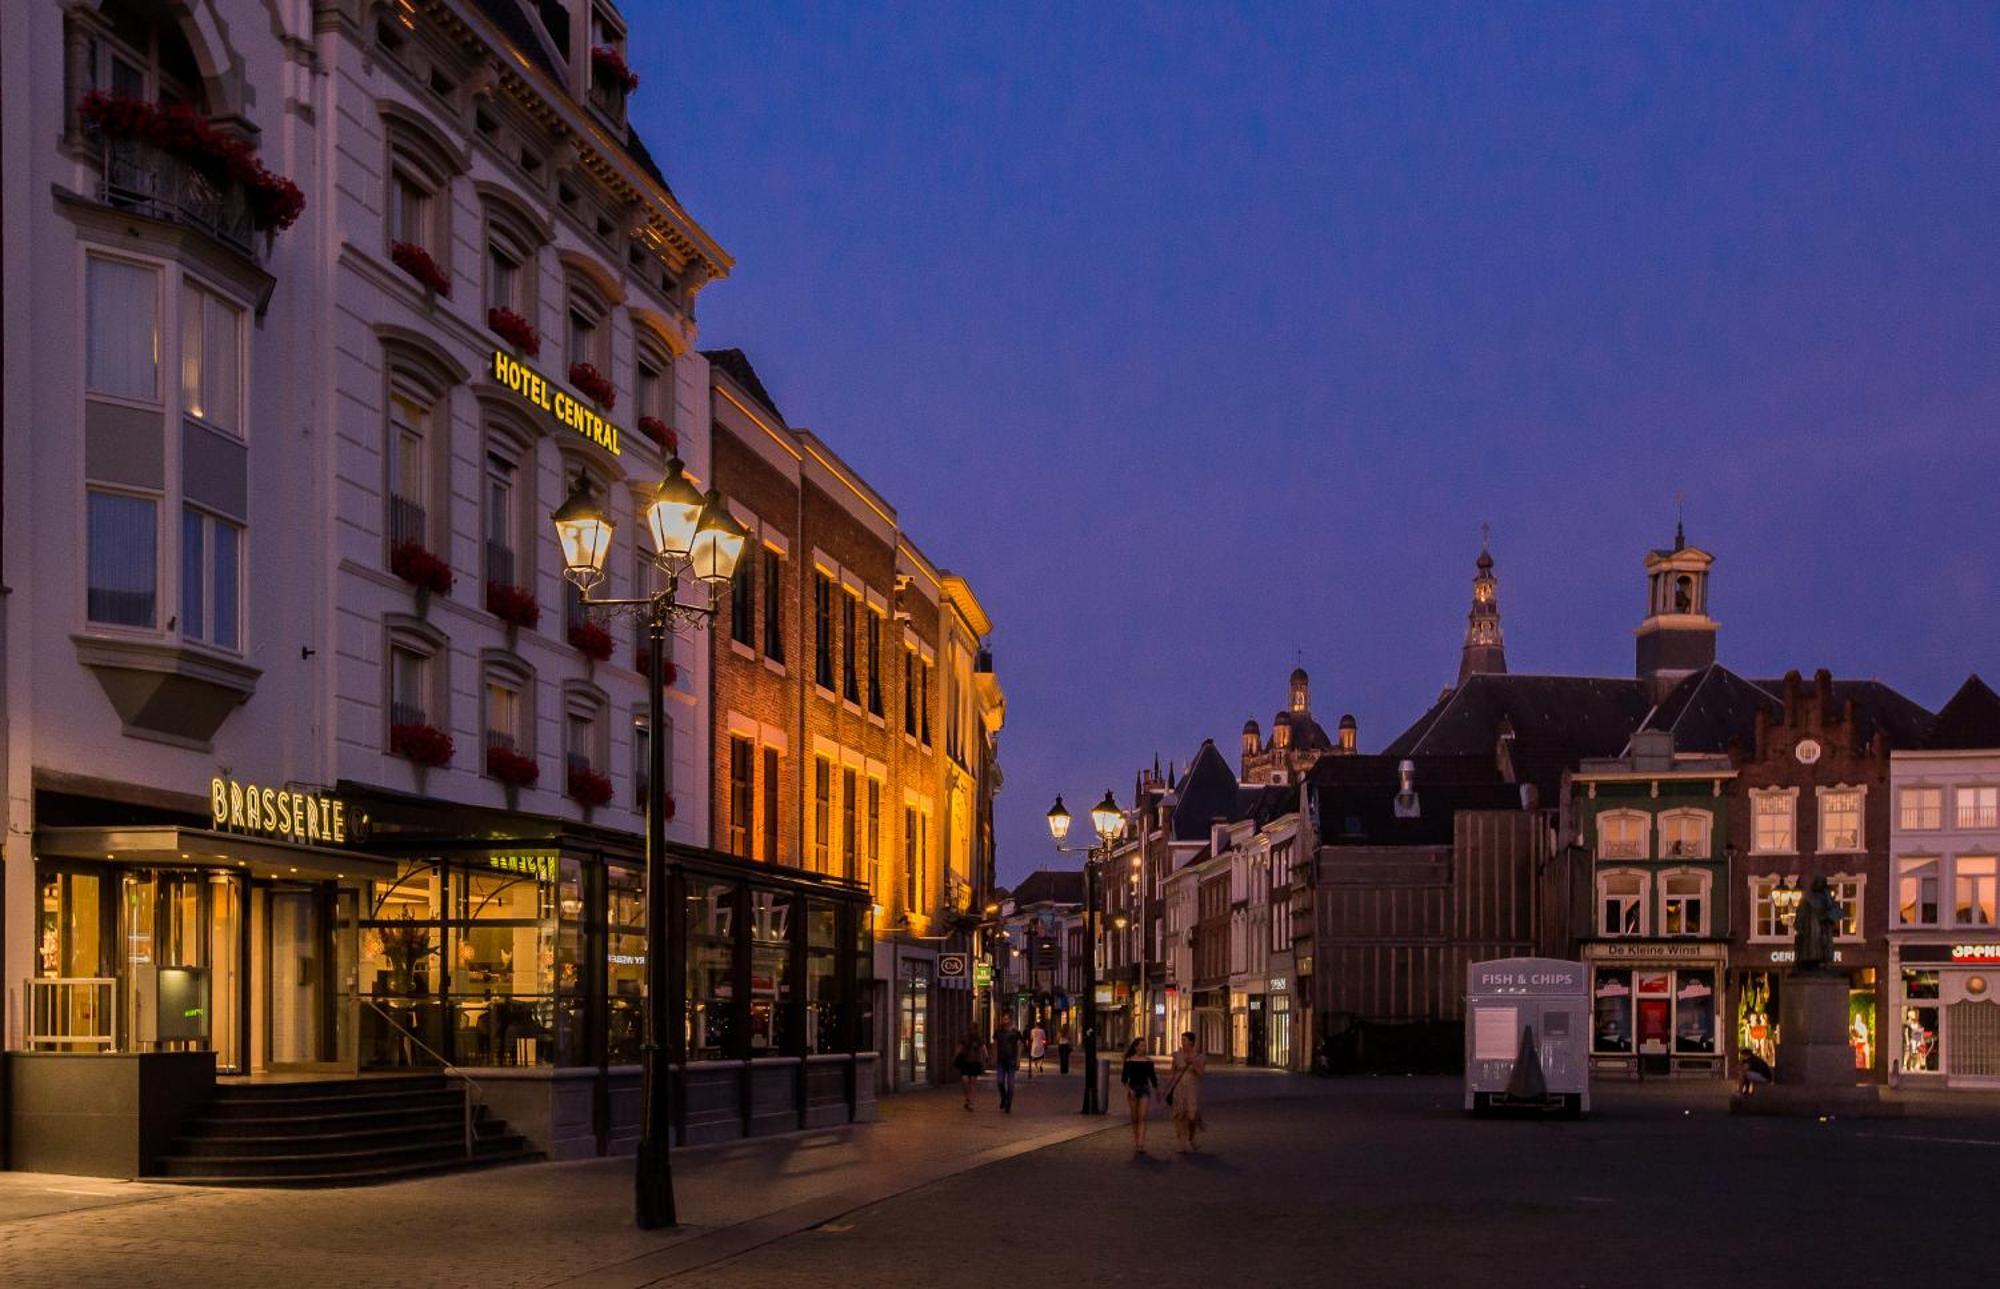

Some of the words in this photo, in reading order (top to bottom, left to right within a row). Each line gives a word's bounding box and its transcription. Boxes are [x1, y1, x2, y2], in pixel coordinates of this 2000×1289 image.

[495, 350, 550, 411] HOTEL
[554, 391, 620, 456] CENTRAL
[211, 777, 345, 843] BRASSERIE
[1608, 945, 1625, 955] De
[1628, 945, 1664, 955] Kleine
[1667, 945, 1701, 955] Winst
[1482, 974, 1513, 985] FISH
[1518, 974, 1527, 985] &
[1531, 974, 1574, 985] CHIPS
